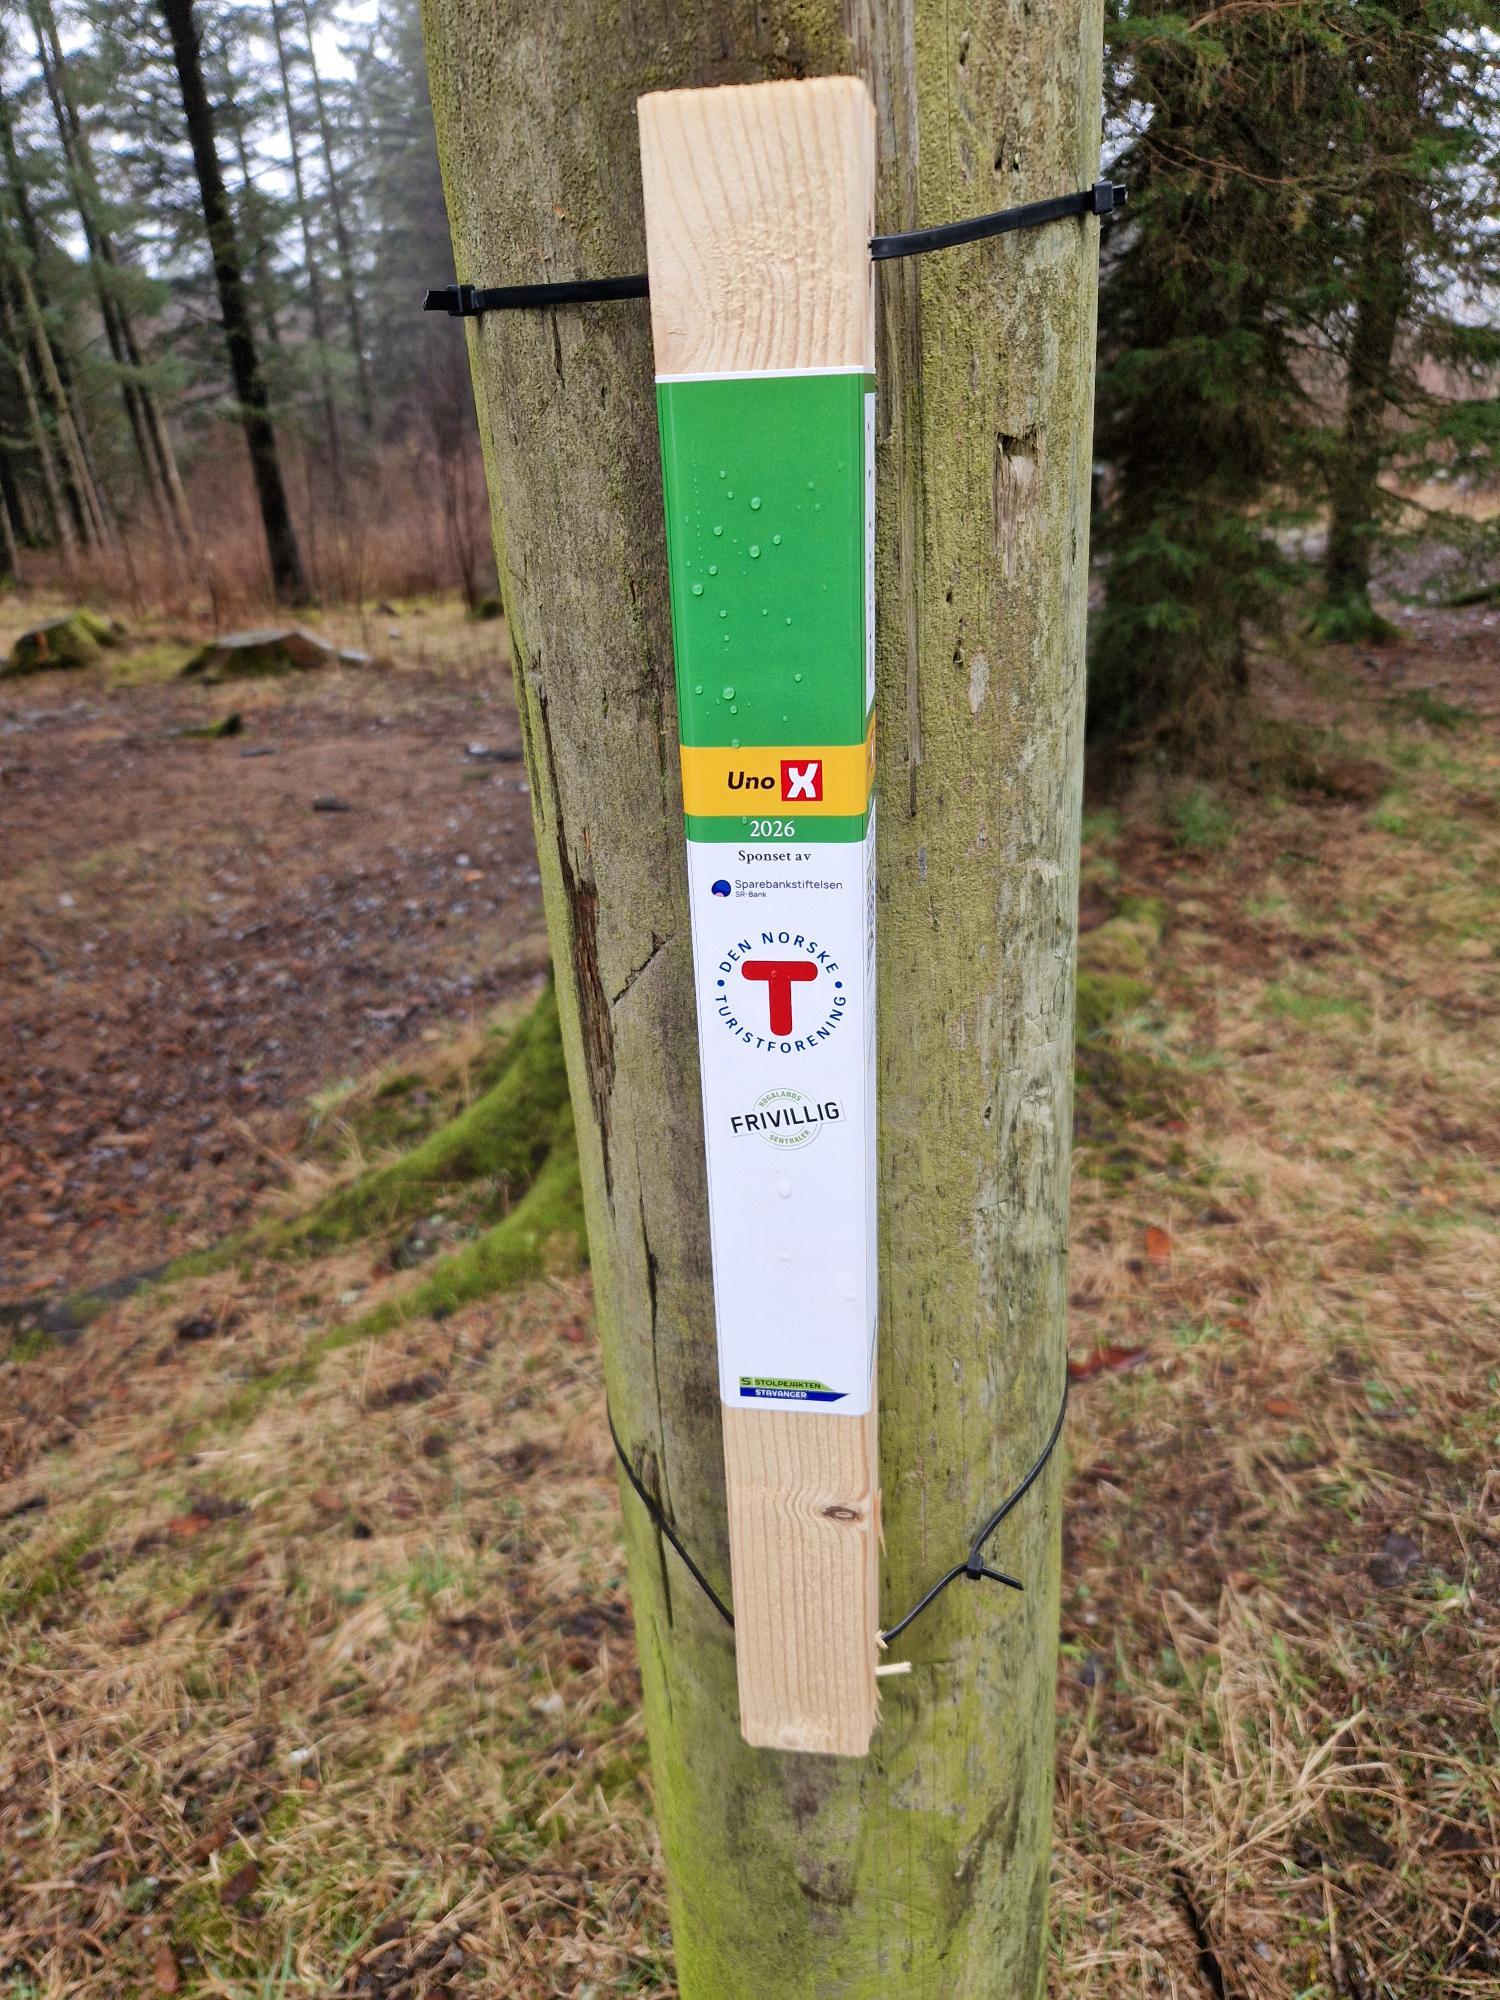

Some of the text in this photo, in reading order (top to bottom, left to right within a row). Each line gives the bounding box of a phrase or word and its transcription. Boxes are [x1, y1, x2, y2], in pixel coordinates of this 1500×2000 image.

[728, 763, 819, 798] Uno X
[750, 820, 795, 837] 2026
[738, 850, 812, 864] Sponset av
[735, 880, 843, 890] Sparebankstiftelsen
[719, 931, 839, 974] DEN NORSKE
[741, 960, 819, 1036] T
[715, 994, 847, 1054] TURISTFORENING
[758, 1090, 802, 1108] ROGALANDS
[730, 1101, 840, 1134] FRIVILLIG
[755, 1379, 821, 1389] STOLPEJAKTEN
[755, 1388, 808, 1399] STAVANGER
